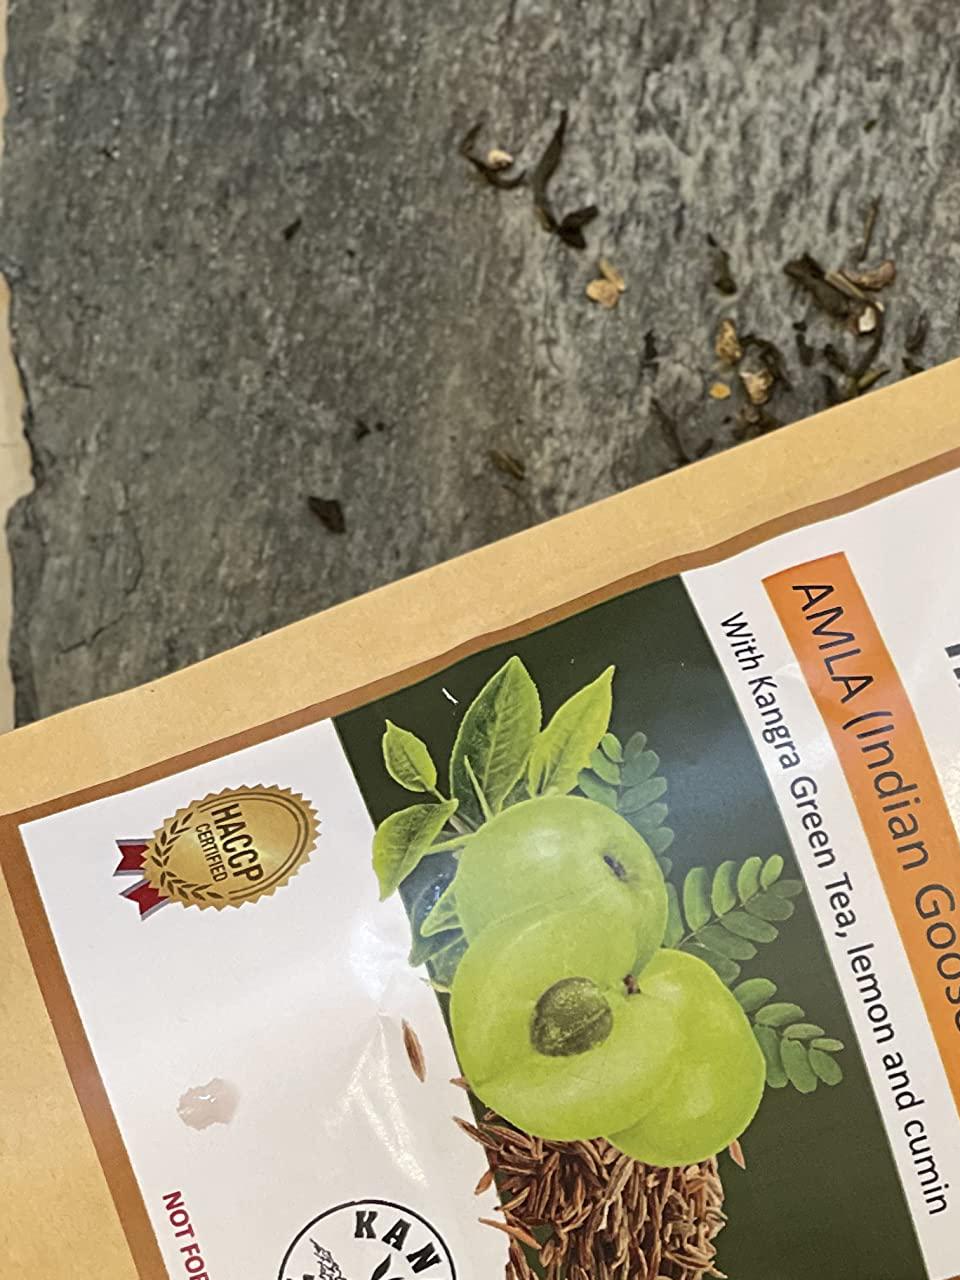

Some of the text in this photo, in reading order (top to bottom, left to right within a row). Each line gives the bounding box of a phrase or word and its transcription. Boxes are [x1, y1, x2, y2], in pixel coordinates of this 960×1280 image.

[792, 584, 874, 704] AMLA
[842, 711, 929, 871] (Indian
[195, 823, 228, 882] CERTIFIED
[211, 803, 264, 881] HACCP
[720, 611, 949, 1215] With Kangra Green Tea, lemon and cumin
[162, 1190, 195, 1237] NOT
